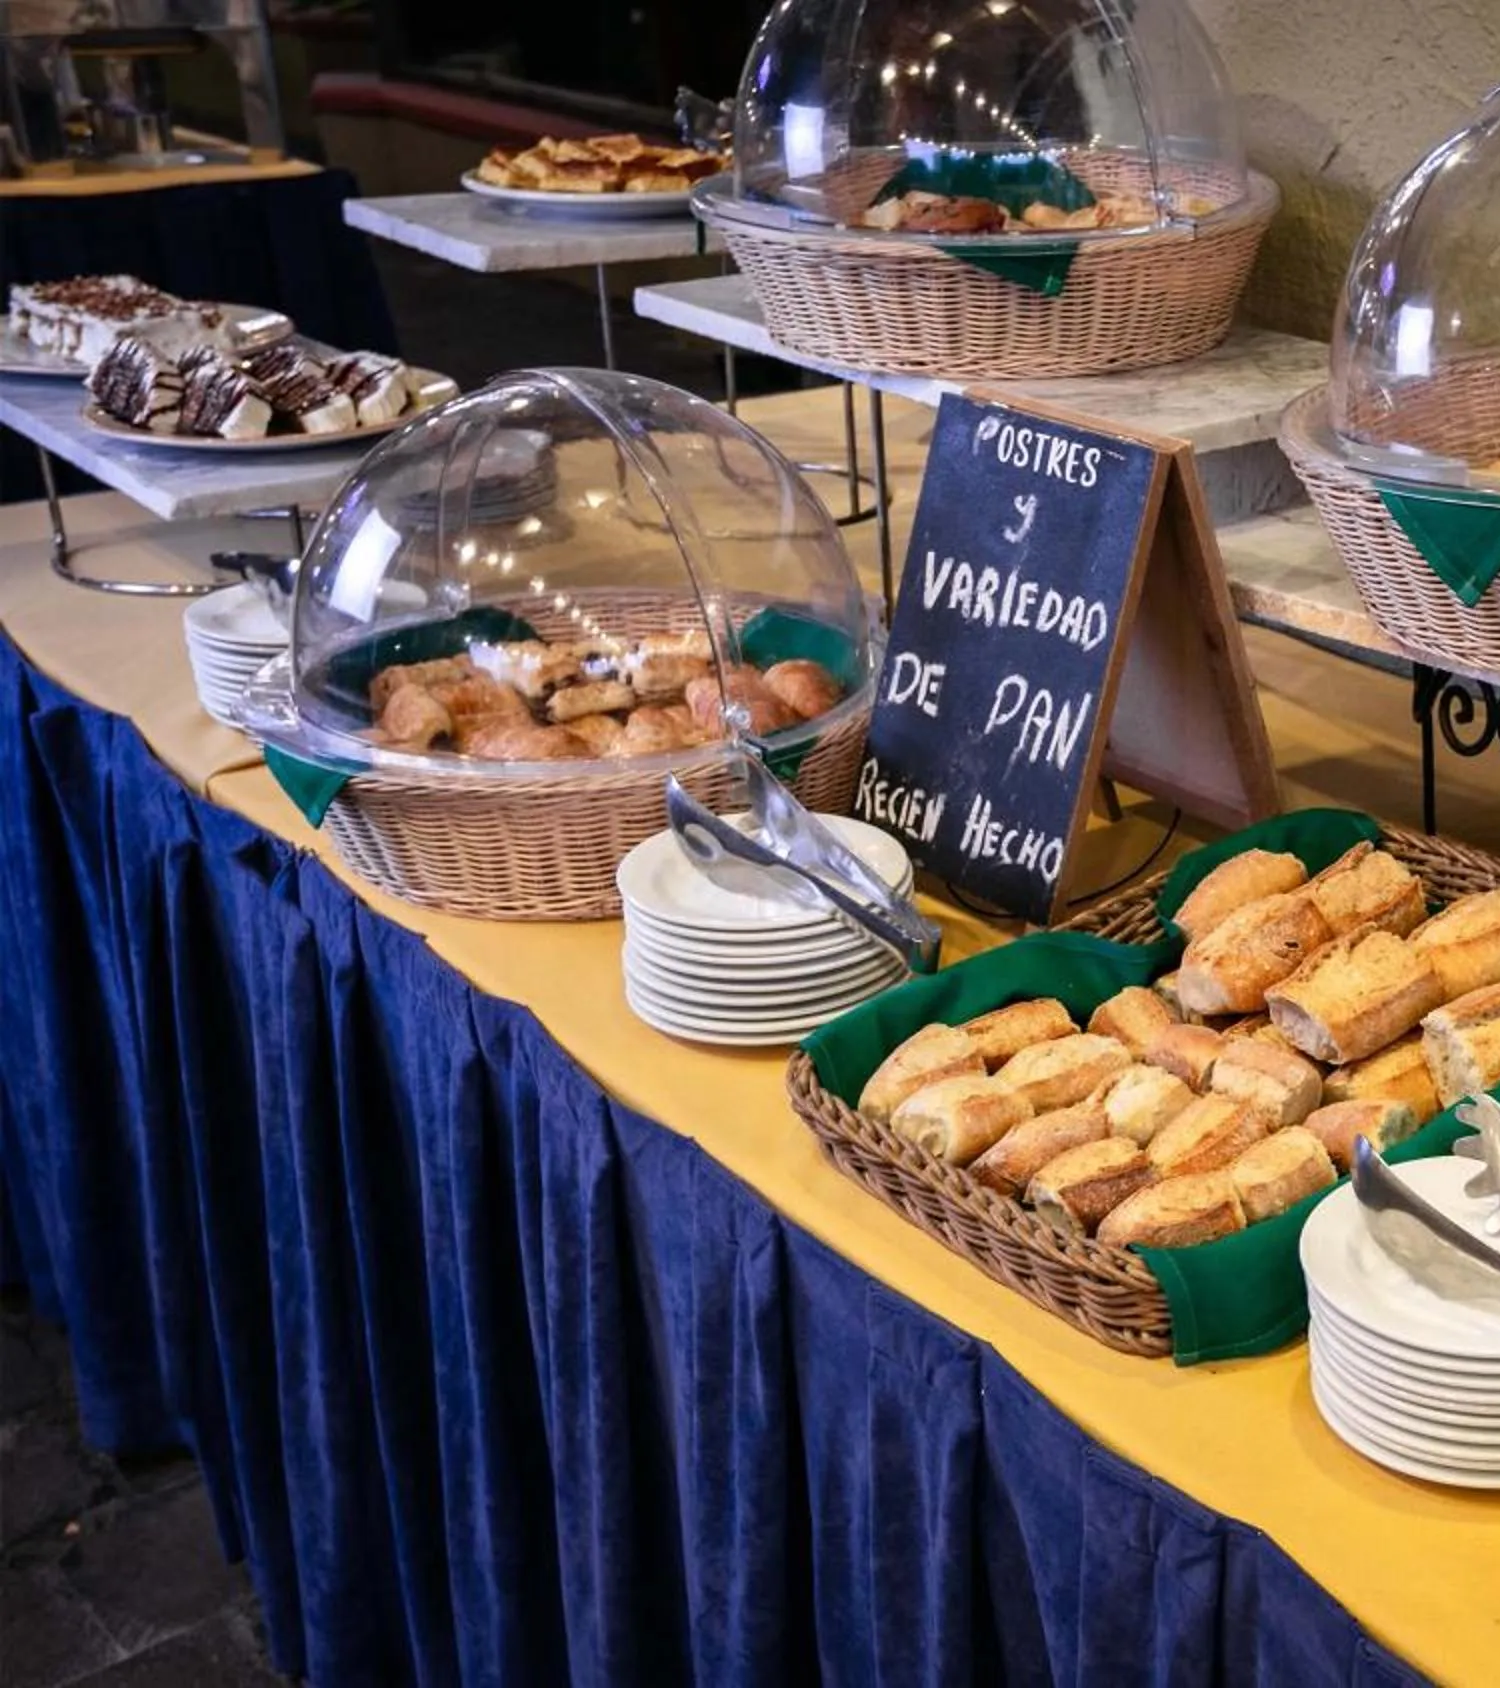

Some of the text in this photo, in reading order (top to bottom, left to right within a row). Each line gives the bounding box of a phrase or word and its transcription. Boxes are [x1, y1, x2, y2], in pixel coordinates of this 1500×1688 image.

[973, 415, 1101, 488] POSTRES
[923, 551, 1107, 652] VARIEDAD
[886, 652, 1092, 771] DE PAN
[855, 757, 1064, 885] RECIEN HECHO
